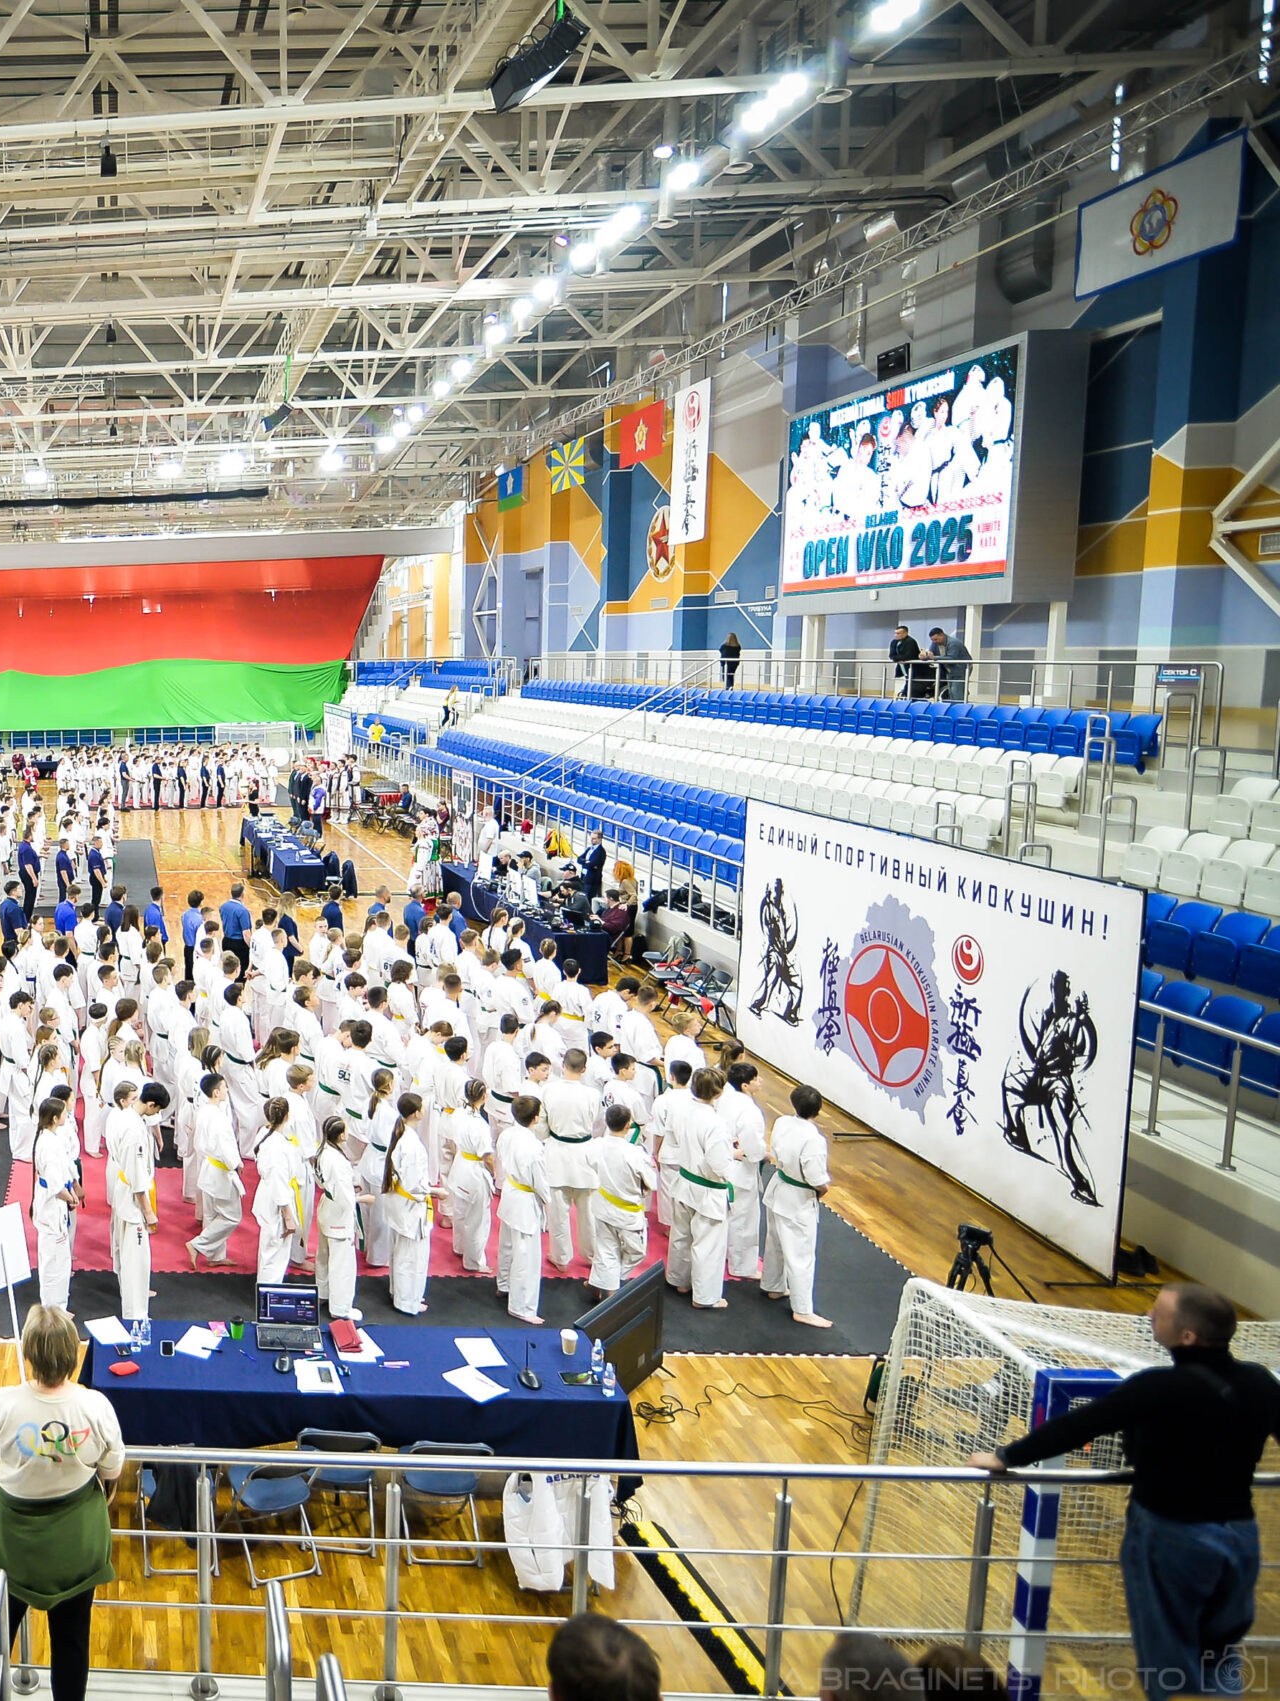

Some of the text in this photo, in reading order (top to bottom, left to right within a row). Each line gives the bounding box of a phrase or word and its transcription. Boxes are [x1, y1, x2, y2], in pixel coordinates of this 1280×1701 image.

[803, 535, 849, 579] OPEN
[856, 526, 904, 572] WKO
[909, 514, 974, 567] 2025
[864, 510, 899, 529] BELARUS
[759, 823, 1108, 940] ЕДИНЫЙ СПОРТИВНЫЙ КИОКУШИН!
[859, 930, 939, 1098] BELARUSIAN KYOKUSHIN KARATE UNION
